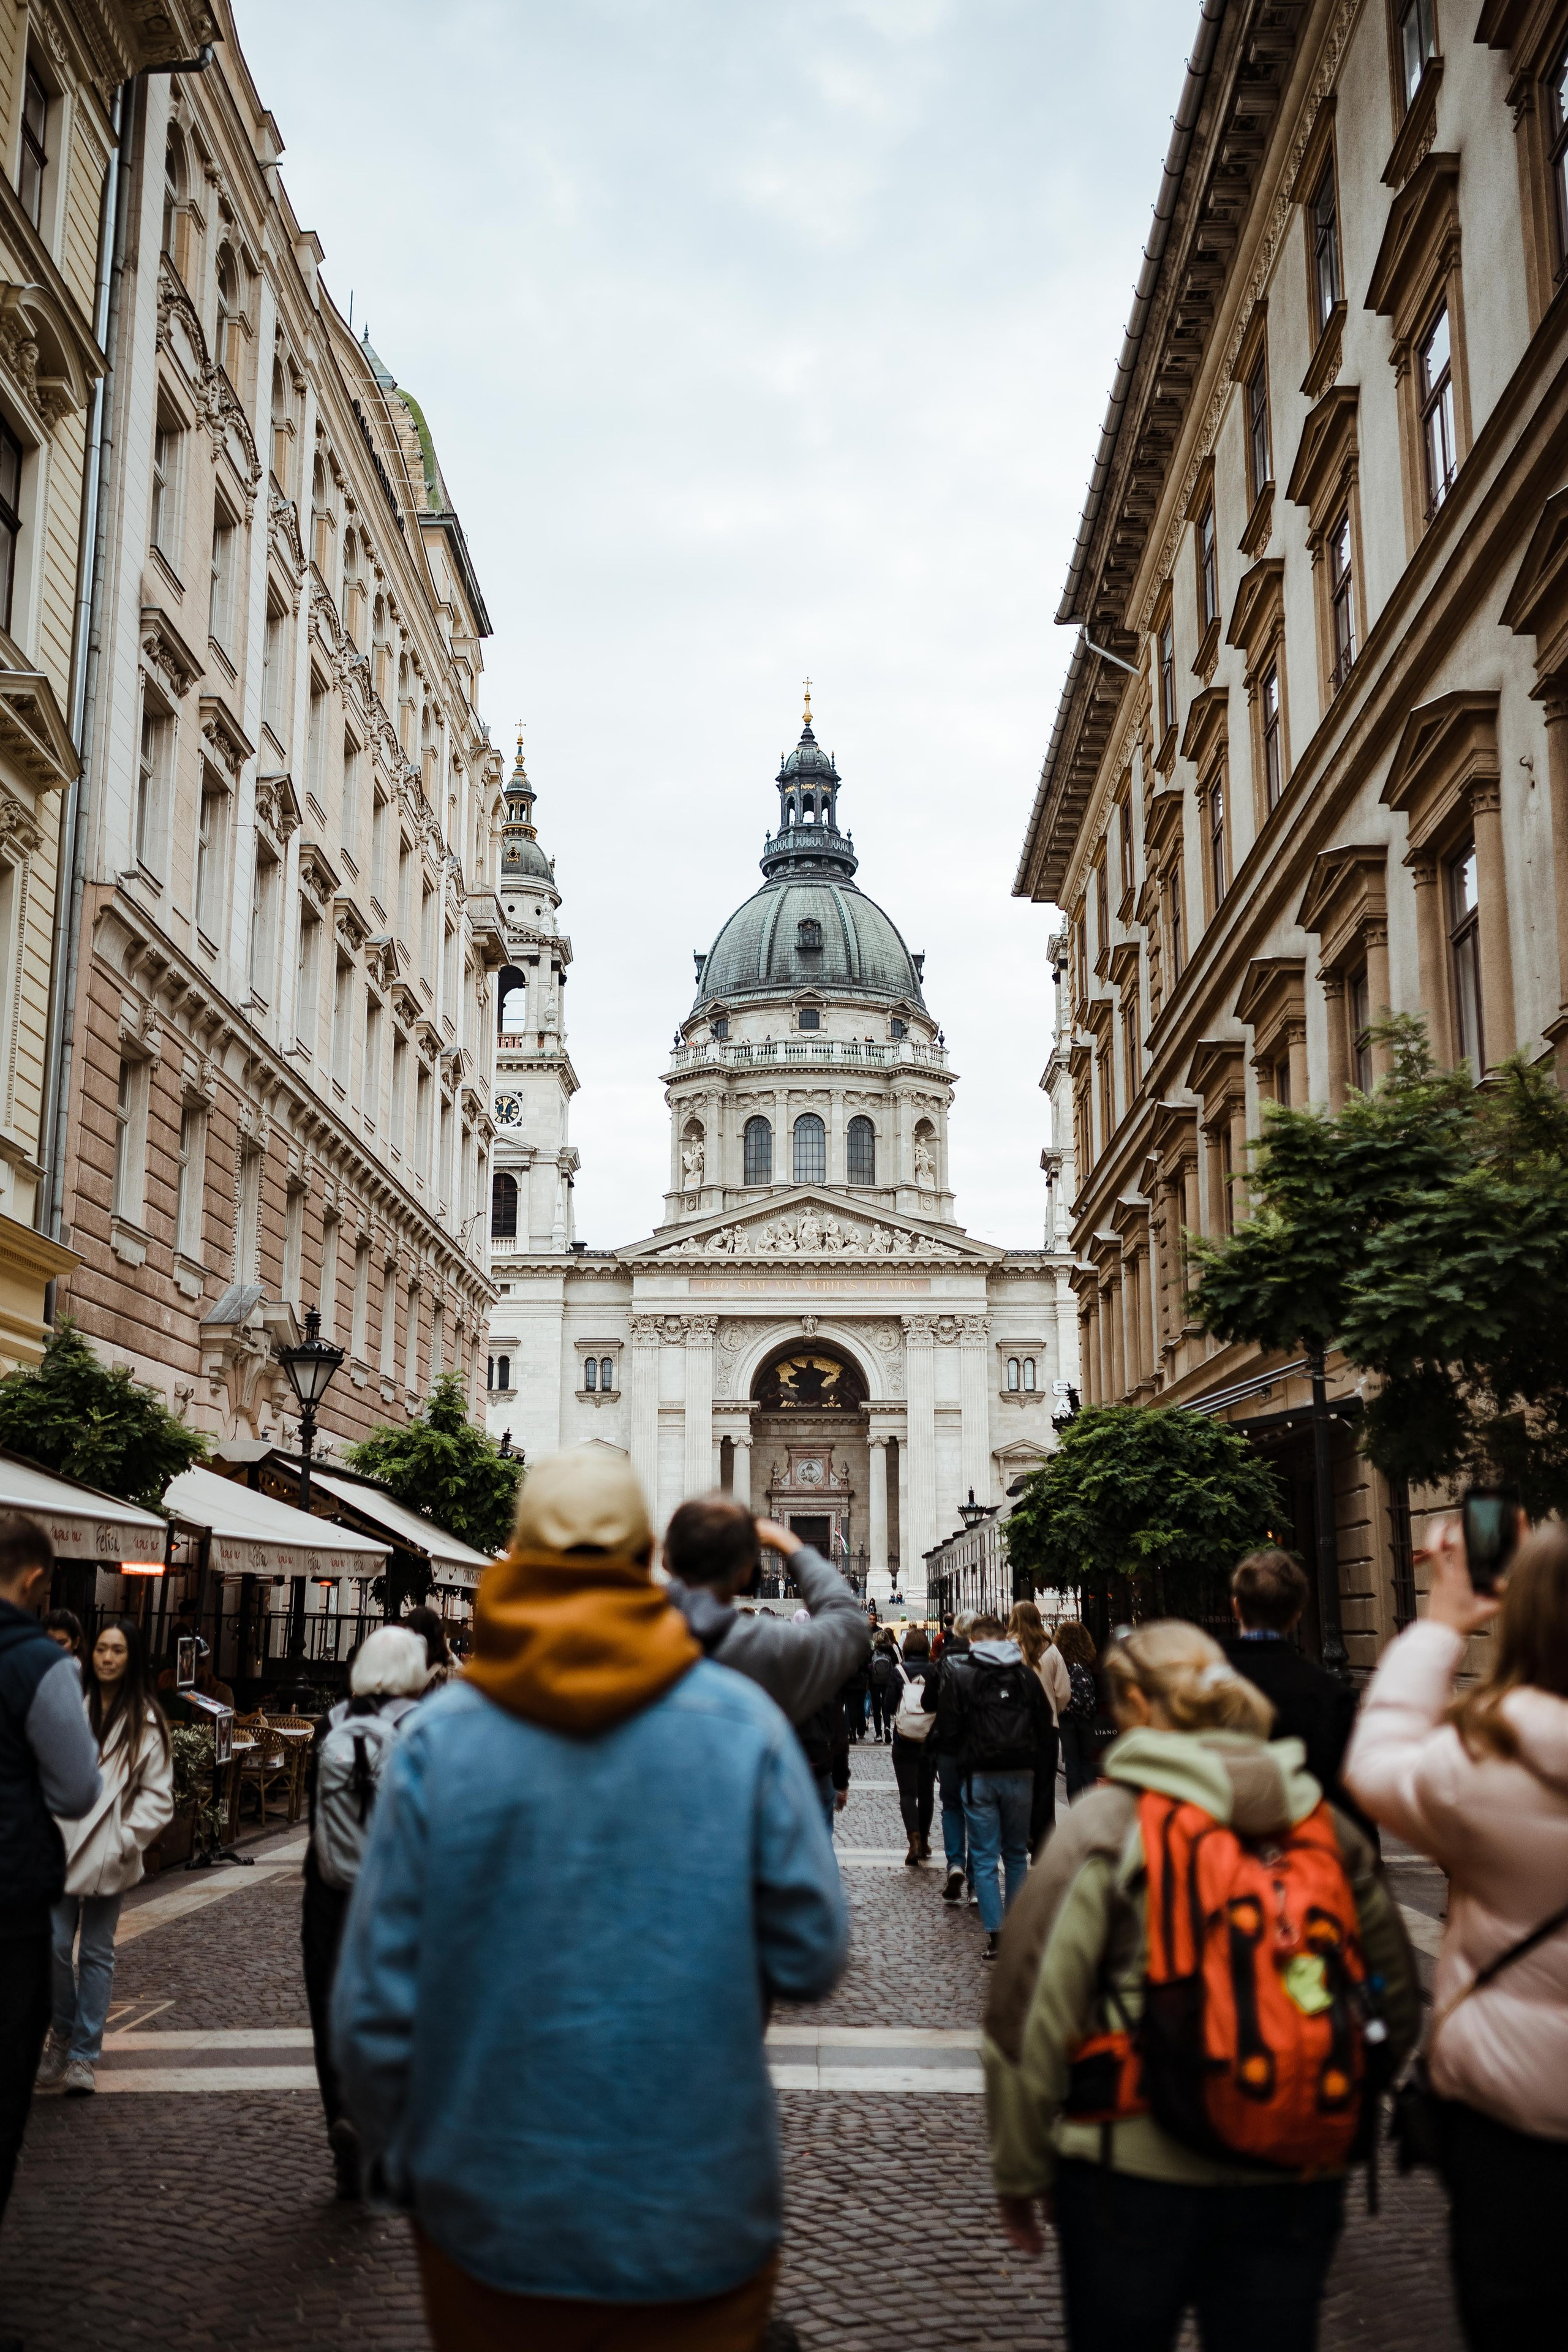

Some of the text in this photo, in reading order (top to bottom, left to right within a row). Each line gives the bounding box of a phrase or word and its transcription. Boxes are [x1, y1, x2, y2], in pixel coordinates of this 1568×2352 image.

[703, 1281, 917, 1291] EGO SUM VIA VERITAS ET VITA
